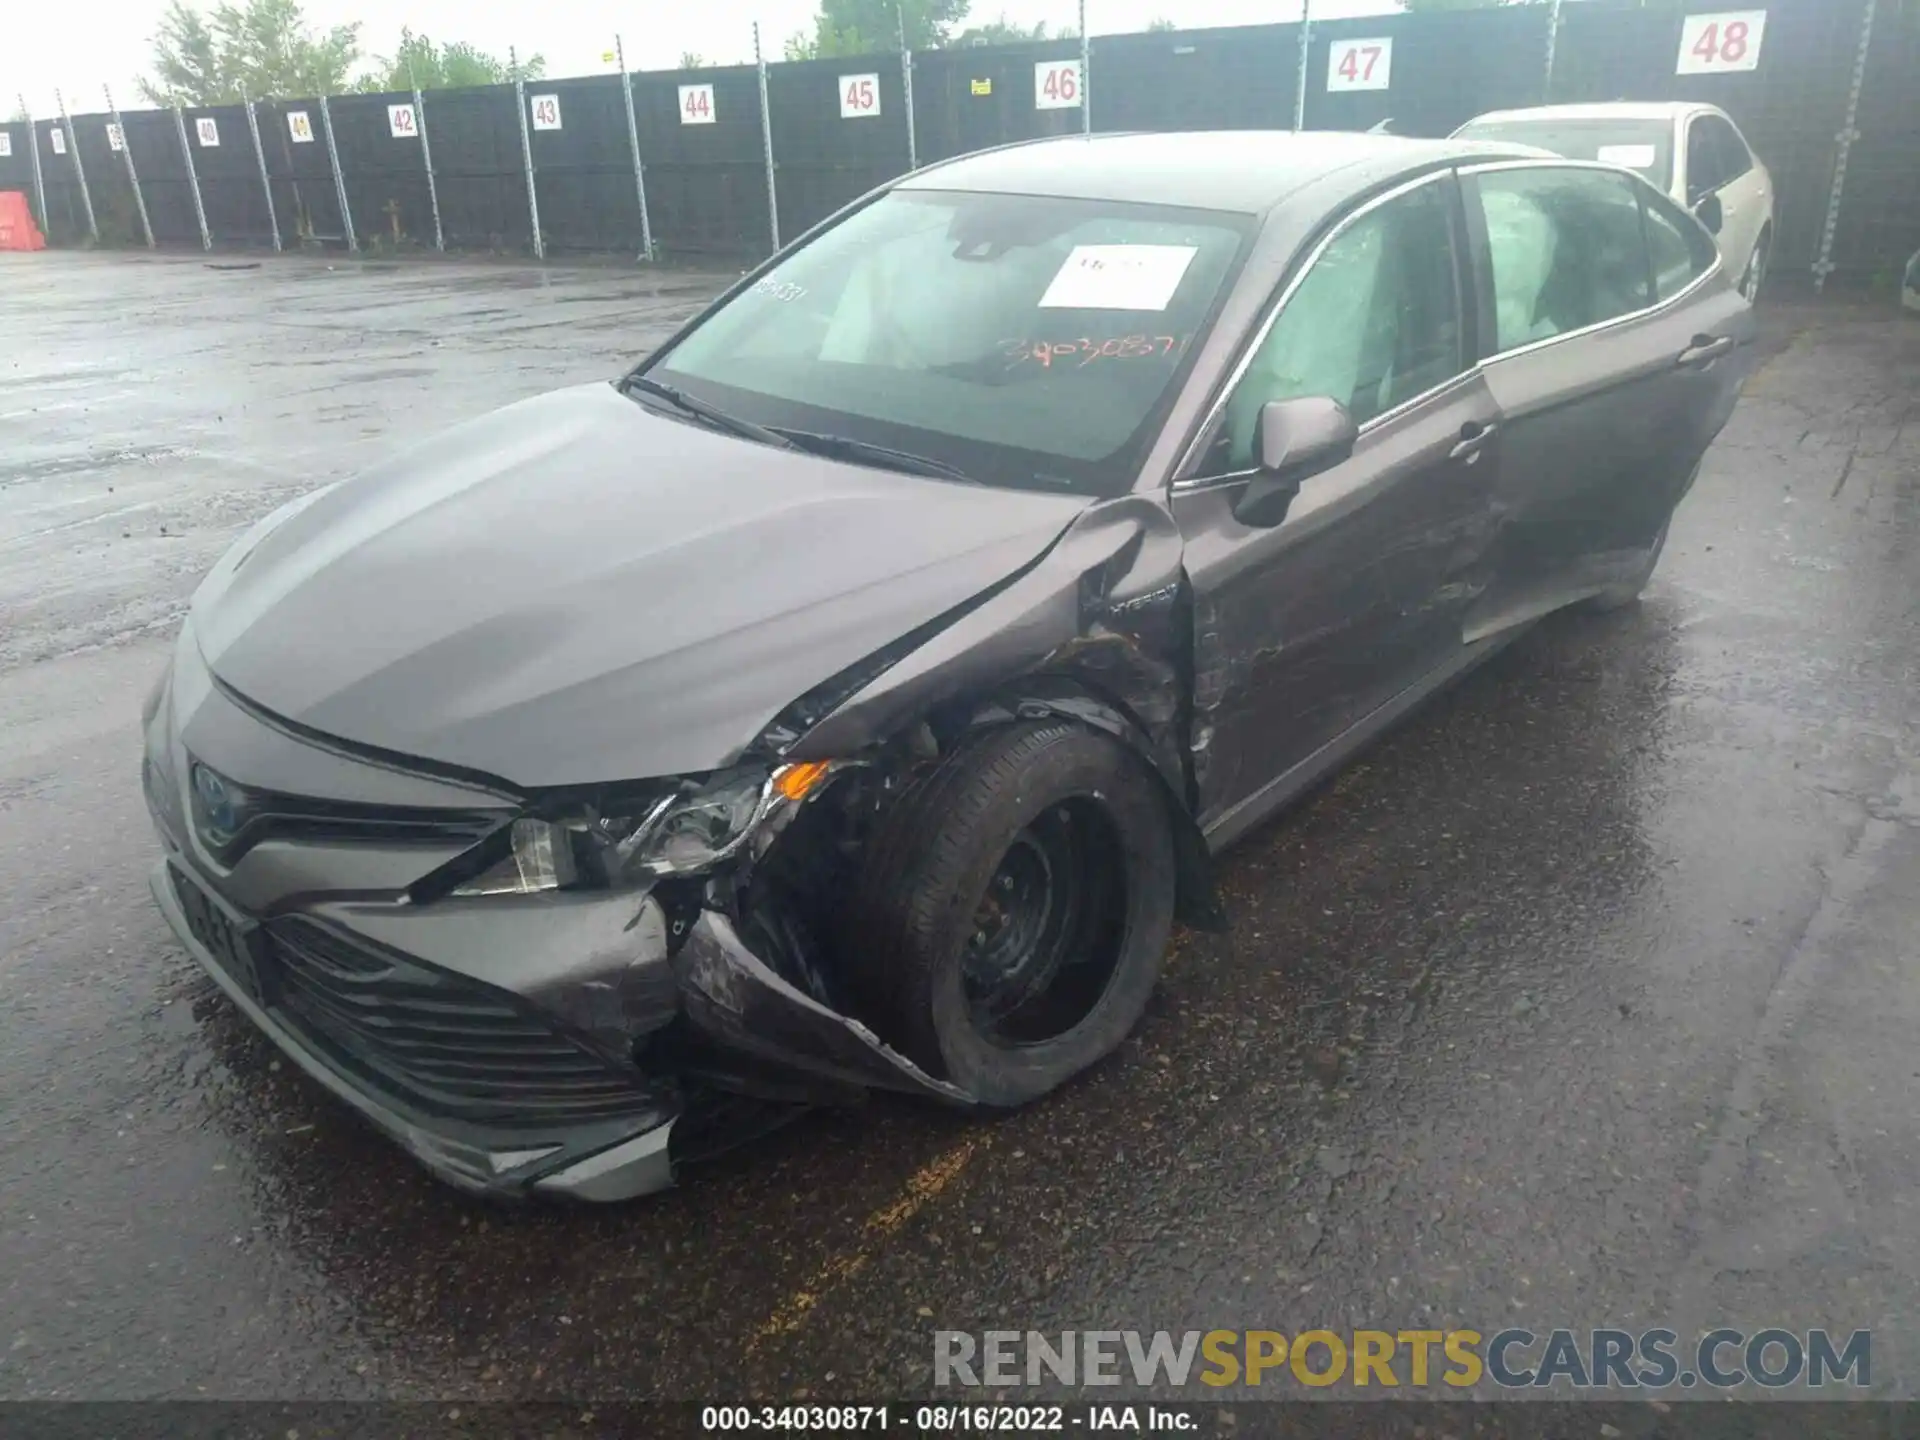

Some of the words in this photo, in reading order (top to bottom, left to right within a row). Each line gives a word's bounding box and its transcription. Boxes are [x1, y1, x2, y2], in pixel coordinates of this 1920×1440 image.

[1692, 22, 1749, 63] 48
[1339, 46, 1382, 82] 47
[847, 81, 873, 110] 45
[1043, 68, 1076, 100] 46
[536, 101, 556, 124] 43
[686, 91, 709, 117] 44
[394, 110, 412, 131] 42
